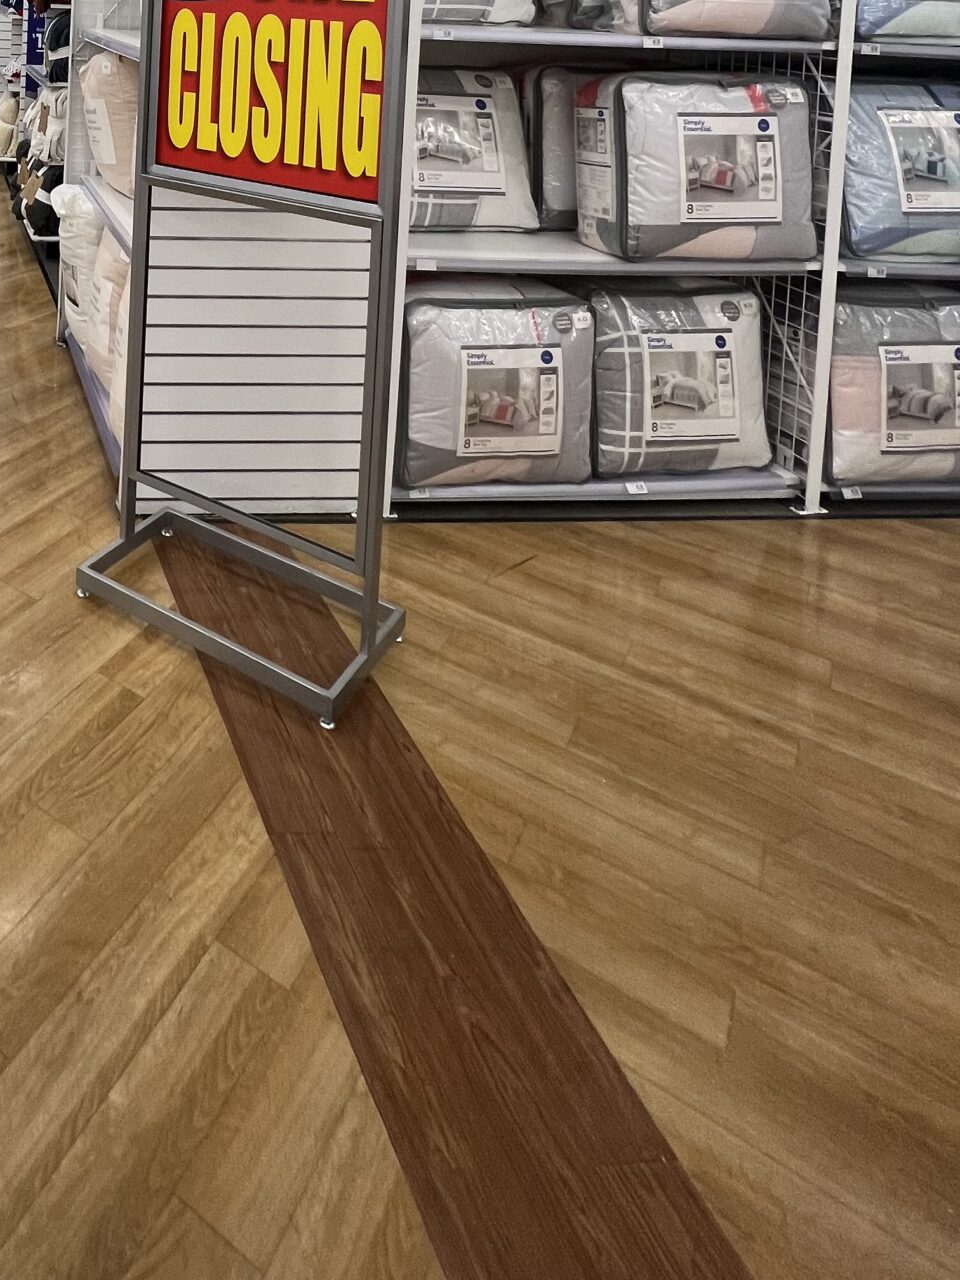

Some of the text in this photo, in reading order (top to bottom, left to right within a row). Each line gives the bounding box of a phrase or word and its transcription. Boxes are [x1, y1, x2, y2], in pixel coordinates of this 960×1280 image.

[168, 8, 382, 178] CLOSING
[686, 204, 694, 214] 8
[651, 422, 659, 432] 8
[886, 432, 894, 443] 8
[463, 438, 471, 449] 8
